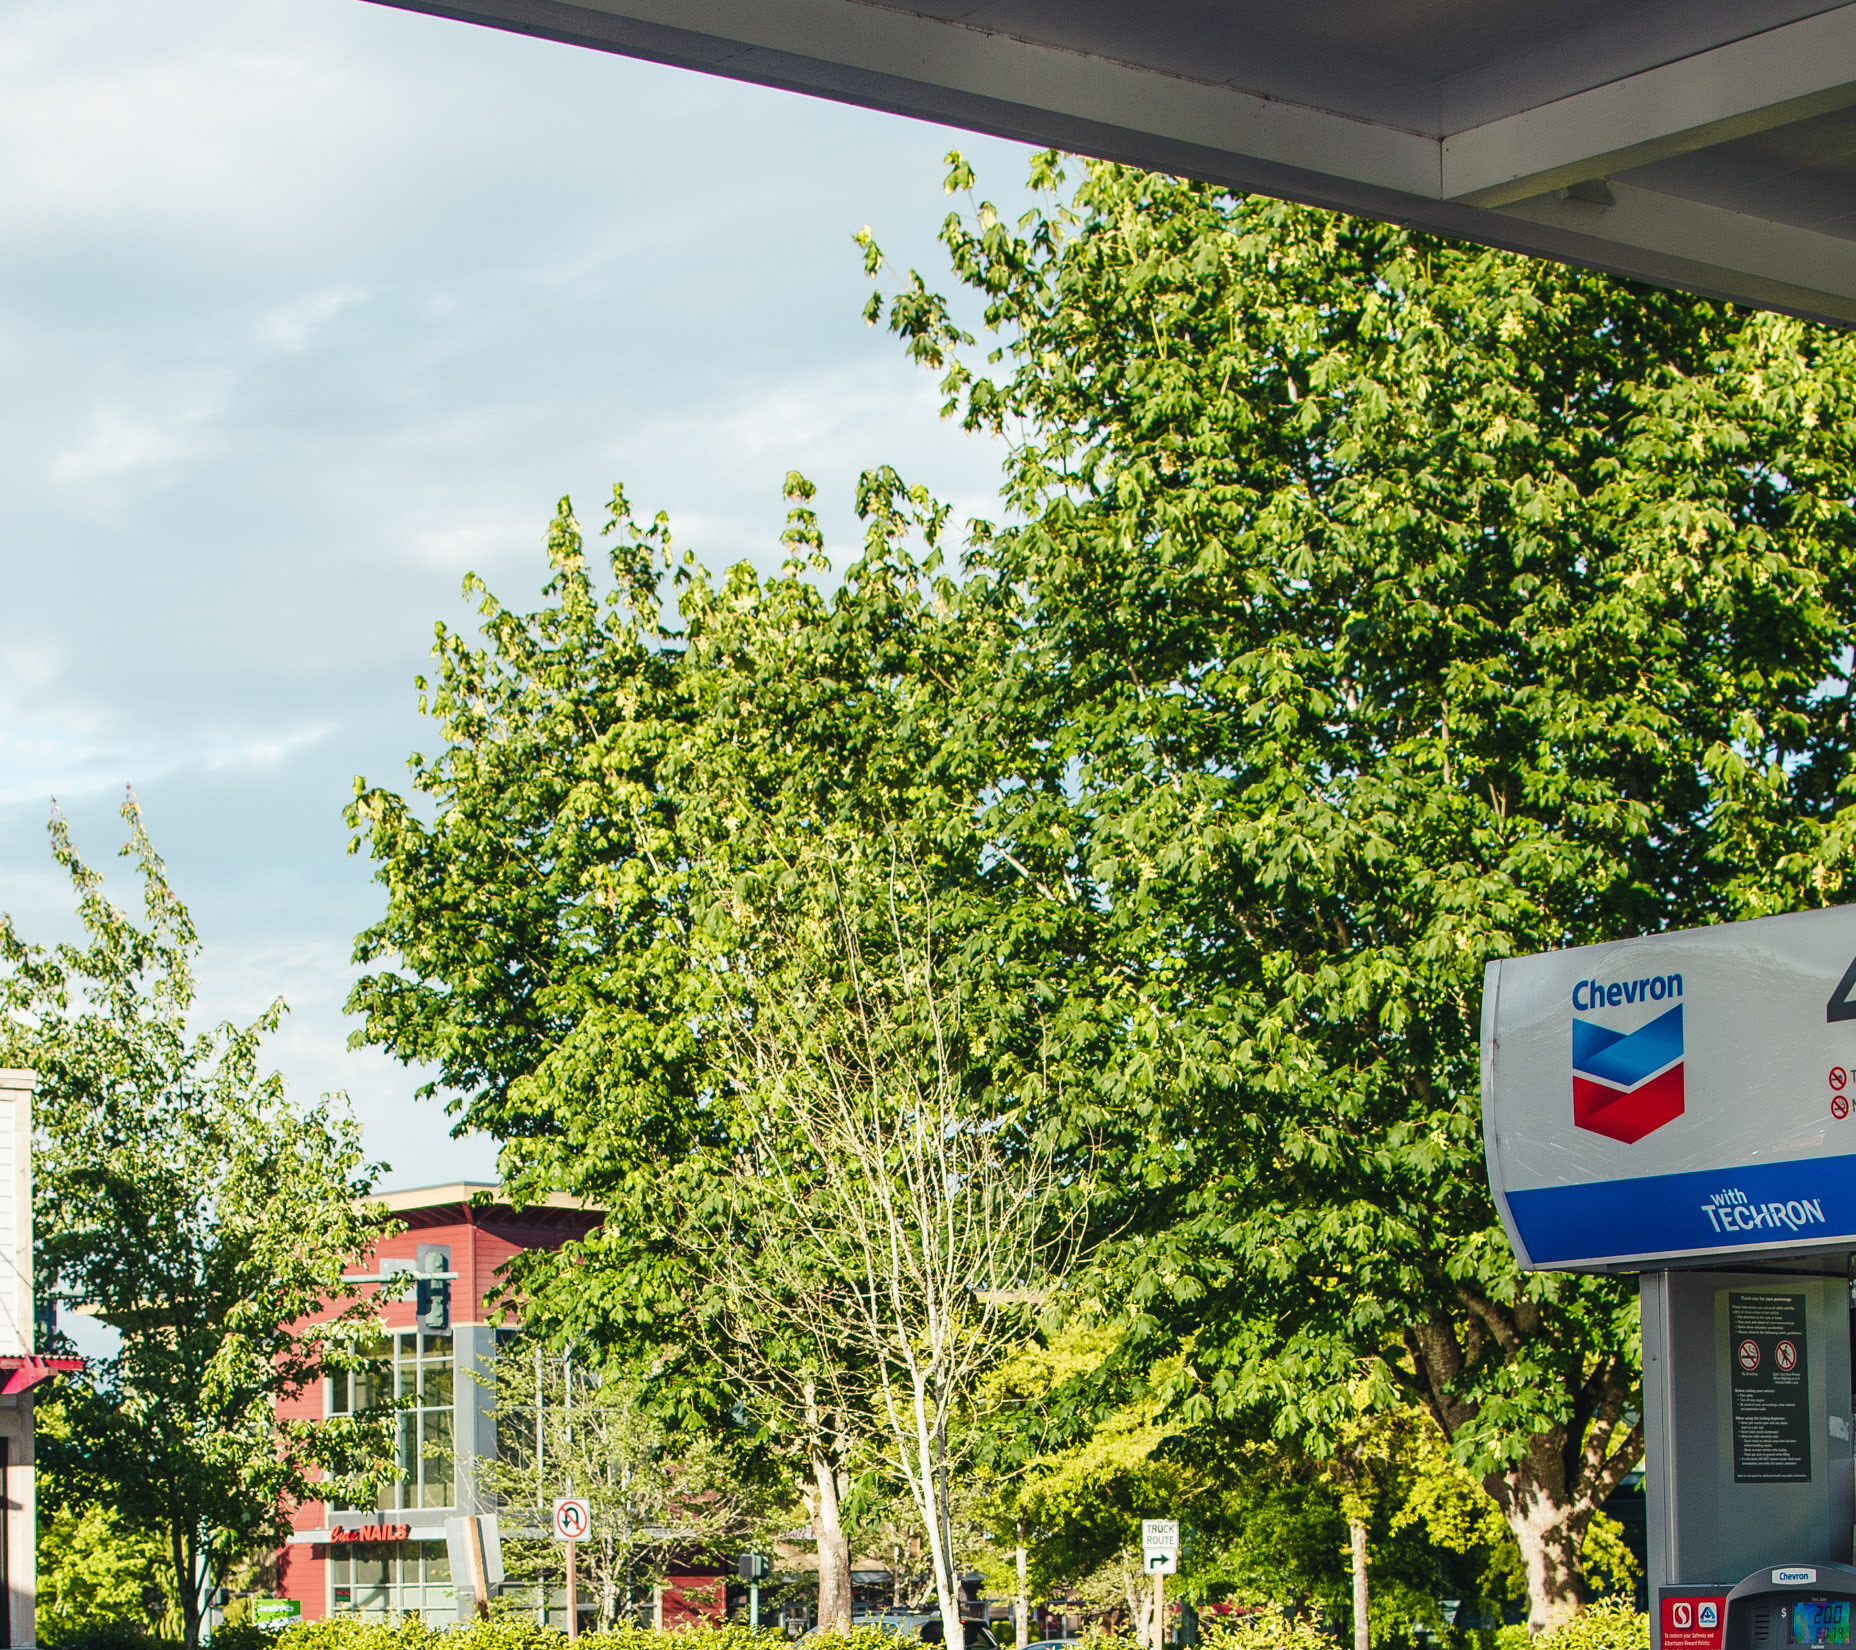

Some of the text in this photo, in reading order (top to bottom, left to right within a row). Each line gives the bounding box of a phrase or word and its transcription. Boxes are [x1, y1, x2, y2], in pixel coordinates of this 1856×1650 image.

[1573, 973, 1684, 1012] Chevron
[1710, 1188, 1748, 1206] with
[1701, 1199, 1826, 1233] TECHRON
[359, 1523, 408, 1542] NAILS
[1146, 1524, 1175, 1534] TRUCK
[1146, 1536, 1175, 1545] ROUTE
[1779, 1572, 1809, 1581] Chevron
[1781, 1607, 1787, 1618] $
